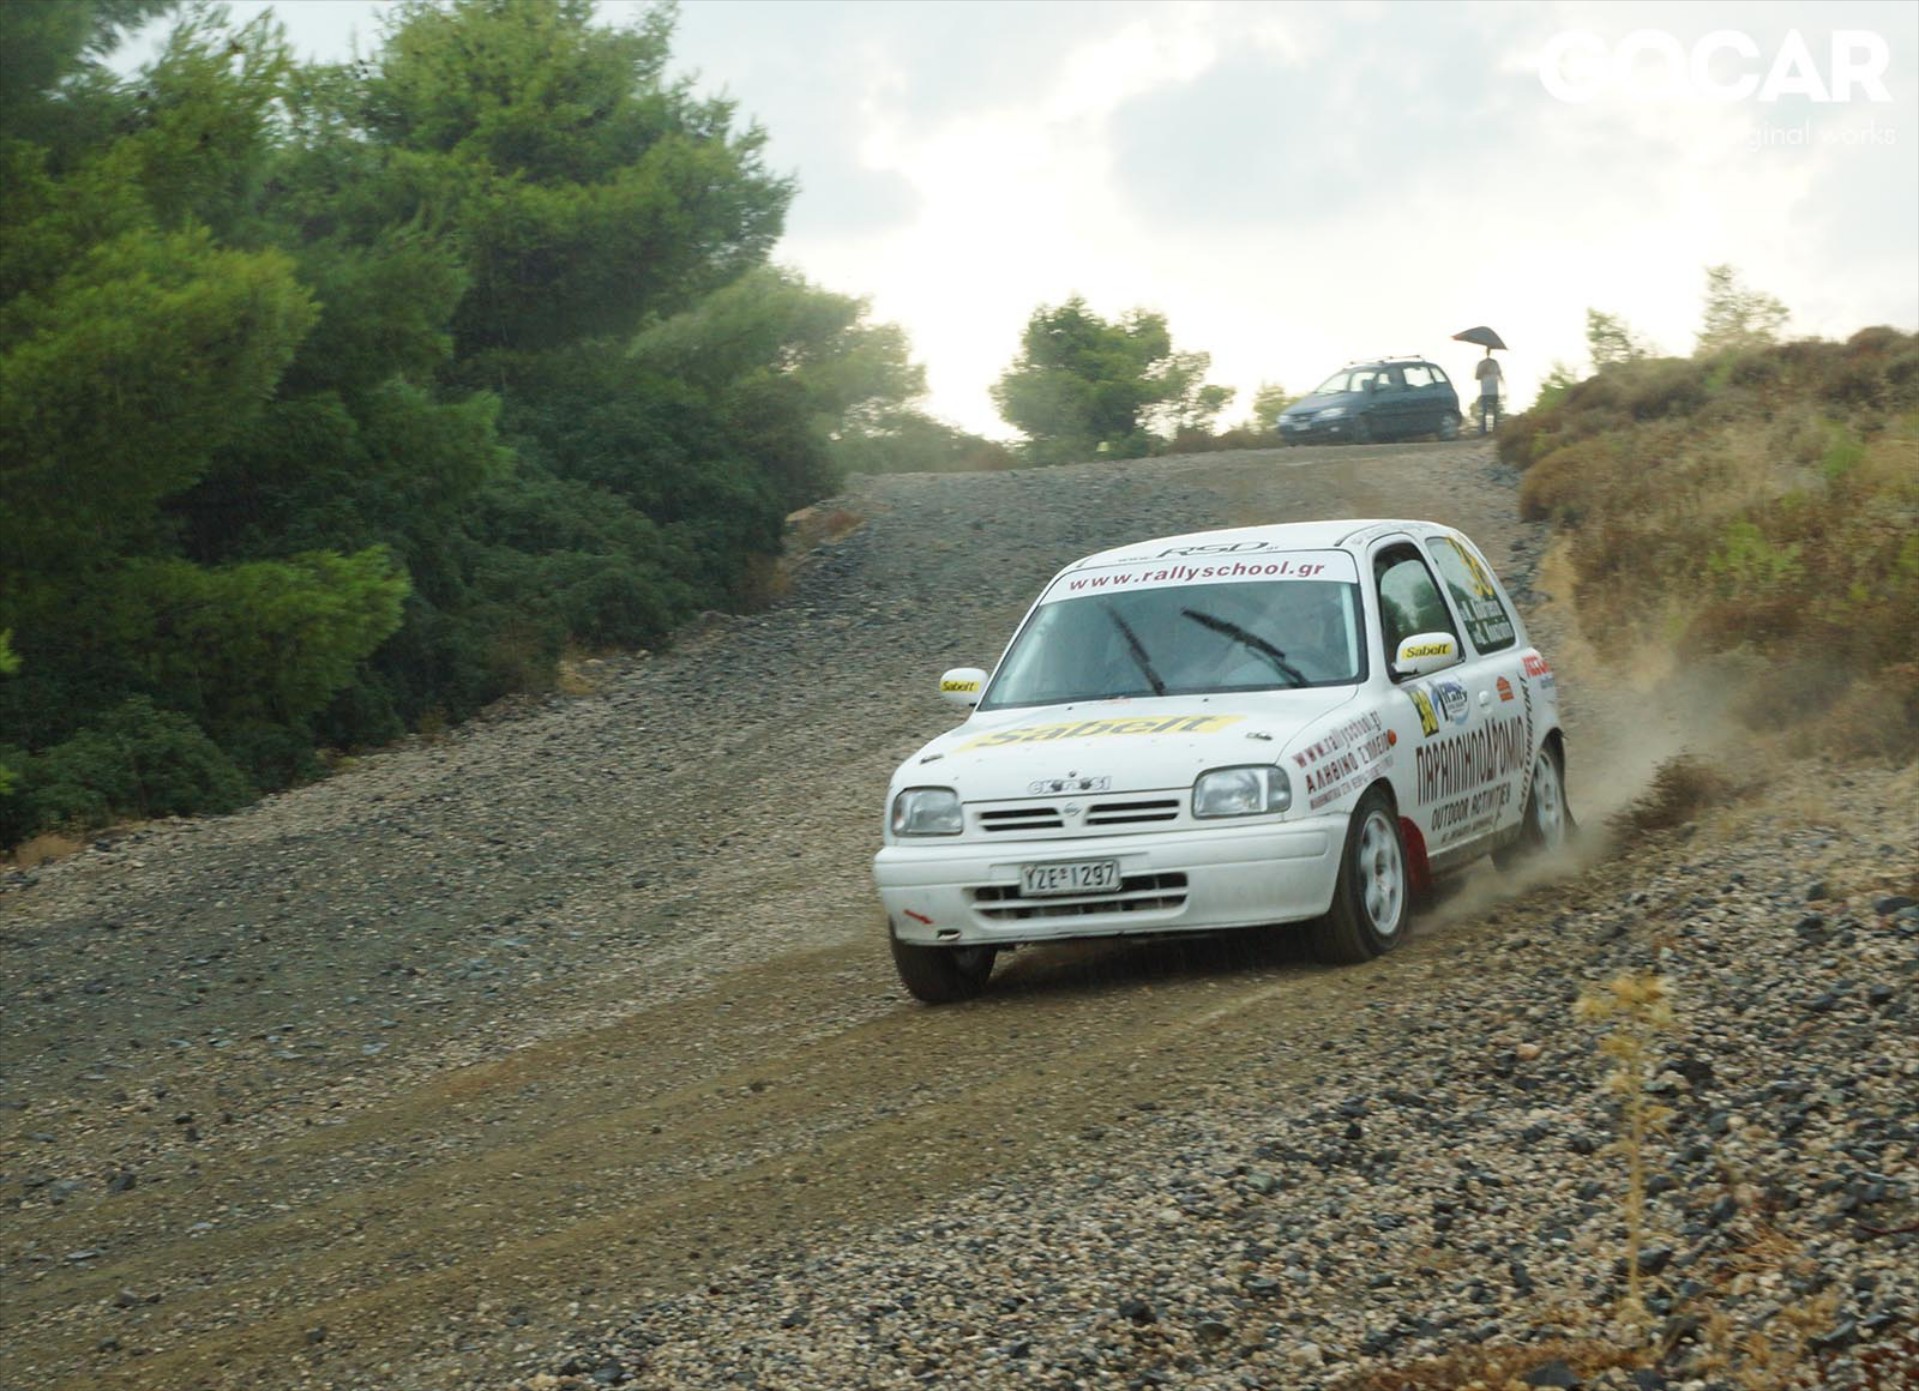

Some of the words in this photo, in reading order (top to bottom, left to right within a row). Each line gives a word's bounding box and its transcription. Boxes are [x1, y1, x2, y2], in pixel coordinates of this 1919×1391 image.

[1069, 561, 1325, 591] www.rallyschool.gr
[1406, 643, 1449, 659] Sabelt
[976, 716, 1217, 747] Sabelt
